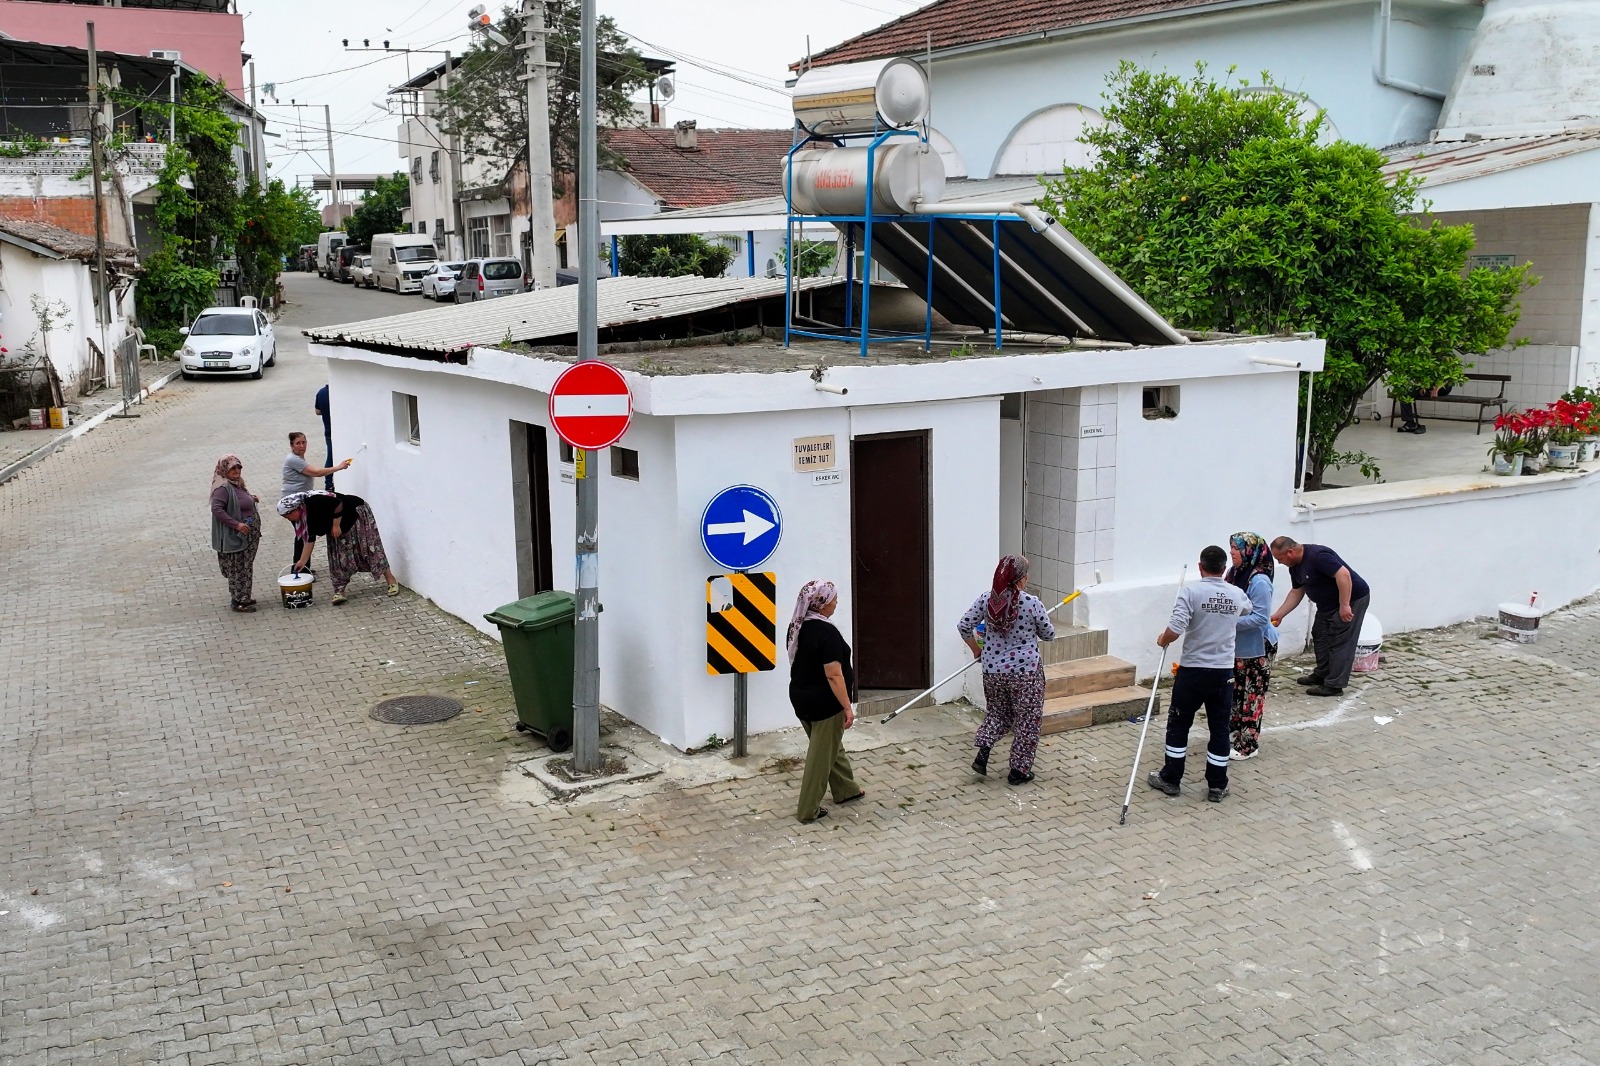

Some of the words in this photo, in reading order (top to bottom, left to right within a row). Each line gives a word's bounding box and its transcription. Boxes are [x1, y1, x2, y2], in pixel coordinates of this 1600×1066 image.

[798, 454, 817, 465] TEMİZ
[818, 454, 829, 463] TUT
[1208, 597, 1234, 605] EFELER
